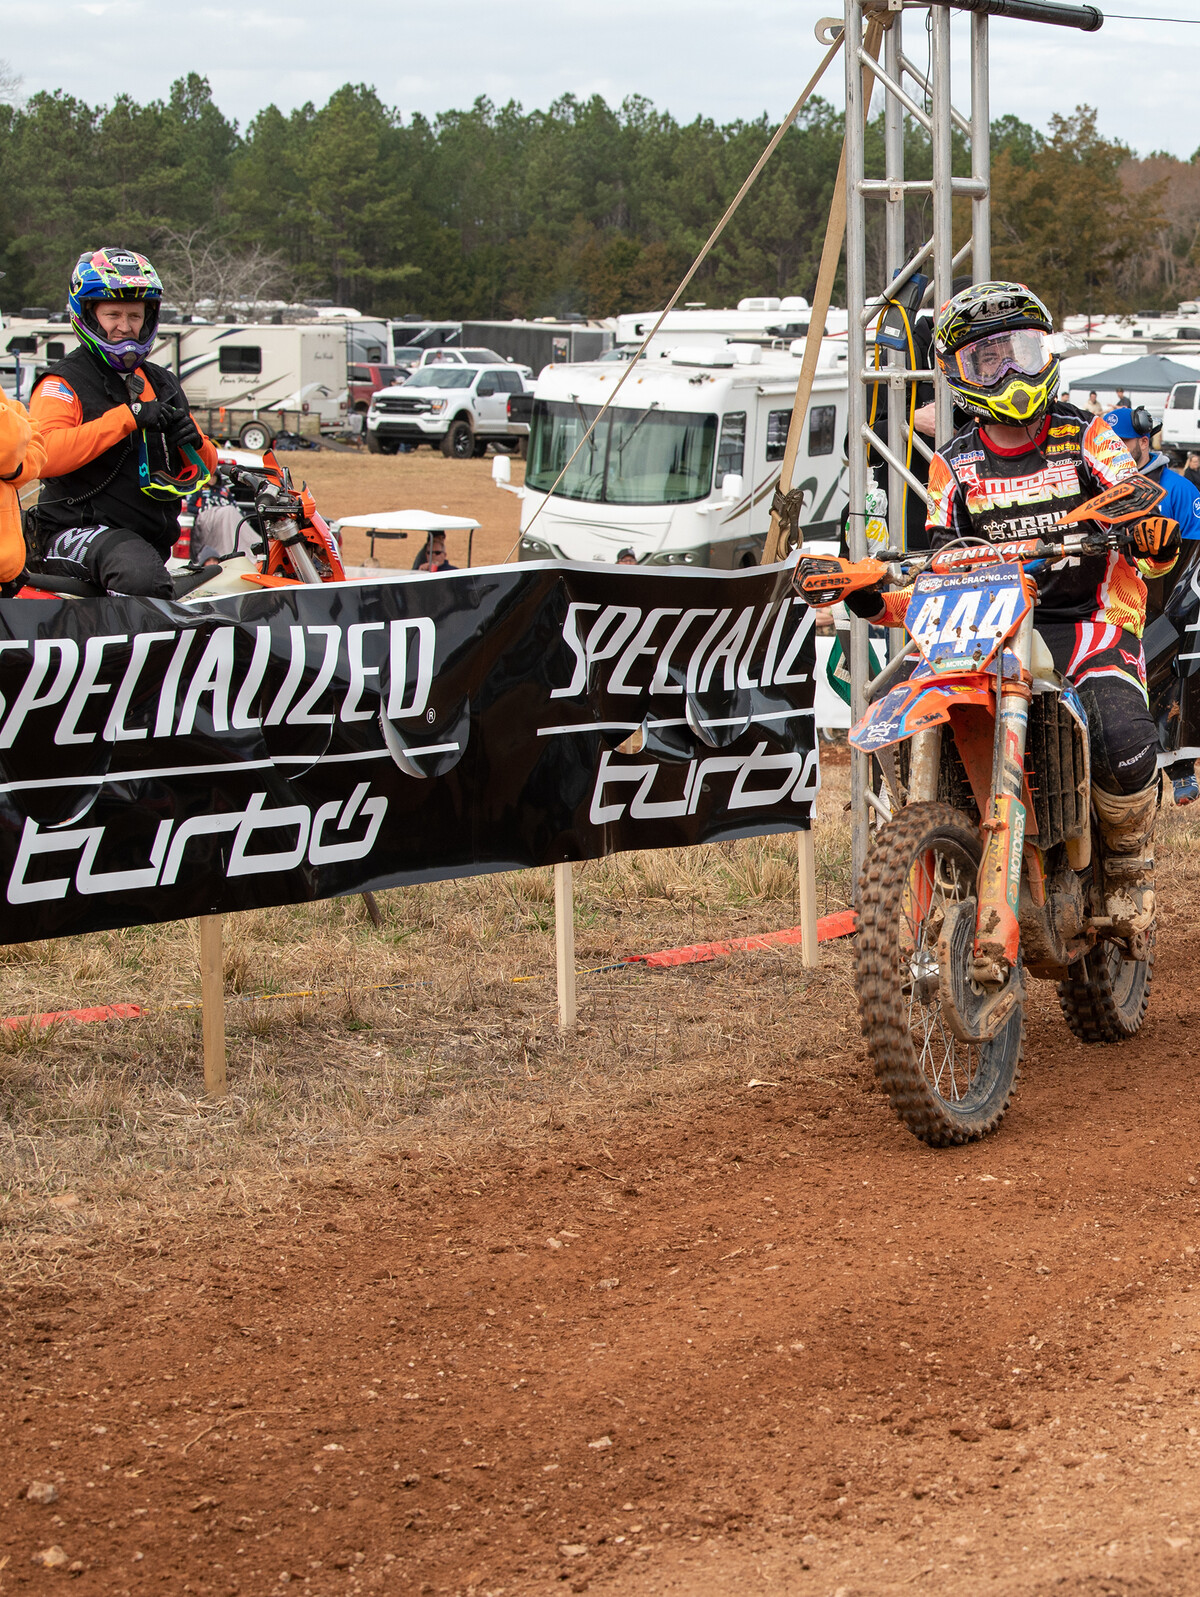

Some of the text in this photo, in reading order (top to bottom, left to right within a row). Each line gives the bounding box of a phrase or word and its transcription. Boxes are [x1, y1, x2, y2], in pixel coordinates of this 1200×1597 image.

[984, 464, 1078, 494] MOOSE
[986, 478, 1081, 509] RACING
[936, 543, 1030, 565] RENTHAL
[550, 597, 816, 699] SPECIALIZ
[911, 586, 1021, 666] 444
[7, 781, 389, 905] turbo
[1008, 809, 1026, 883] MOTOREX
